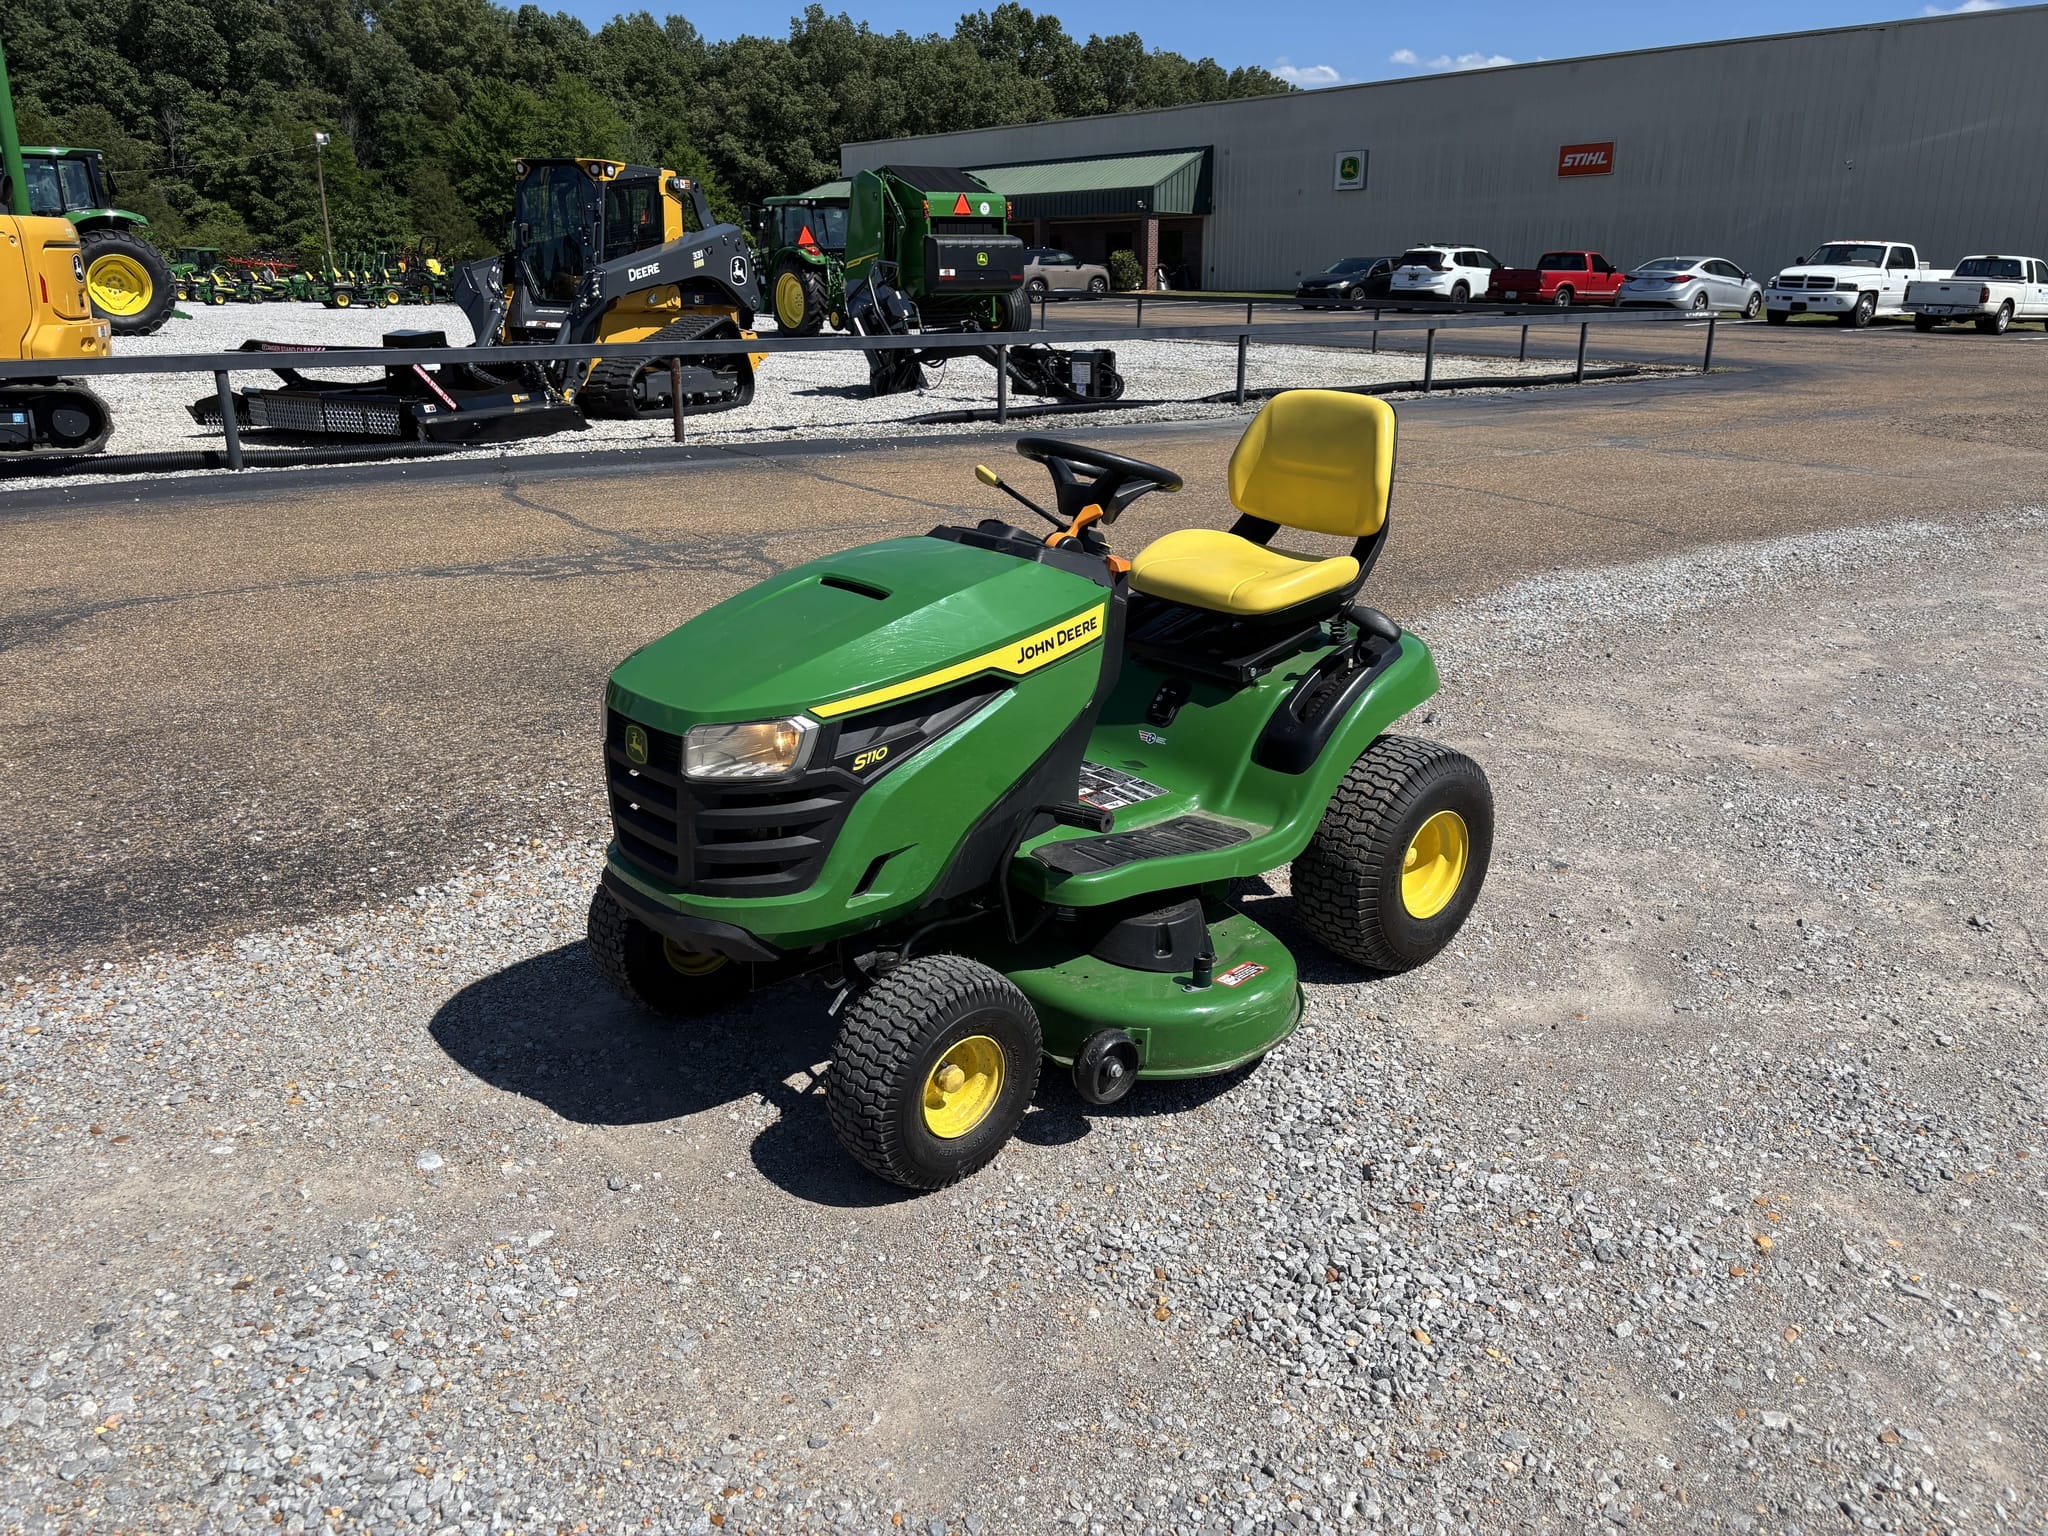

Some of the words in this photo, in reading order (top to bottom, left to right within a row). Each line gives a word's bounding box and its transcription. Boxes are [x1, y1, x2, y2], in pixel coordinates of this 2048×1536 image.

[1562, 152, 1608, 167] STIHL
[628, 262, 660, 282] DEERE
[1017, 637, 1055, 664] JOHN
[1056, 616, 1098, 647] DEERE
[852, 746, 888, 771] S110
